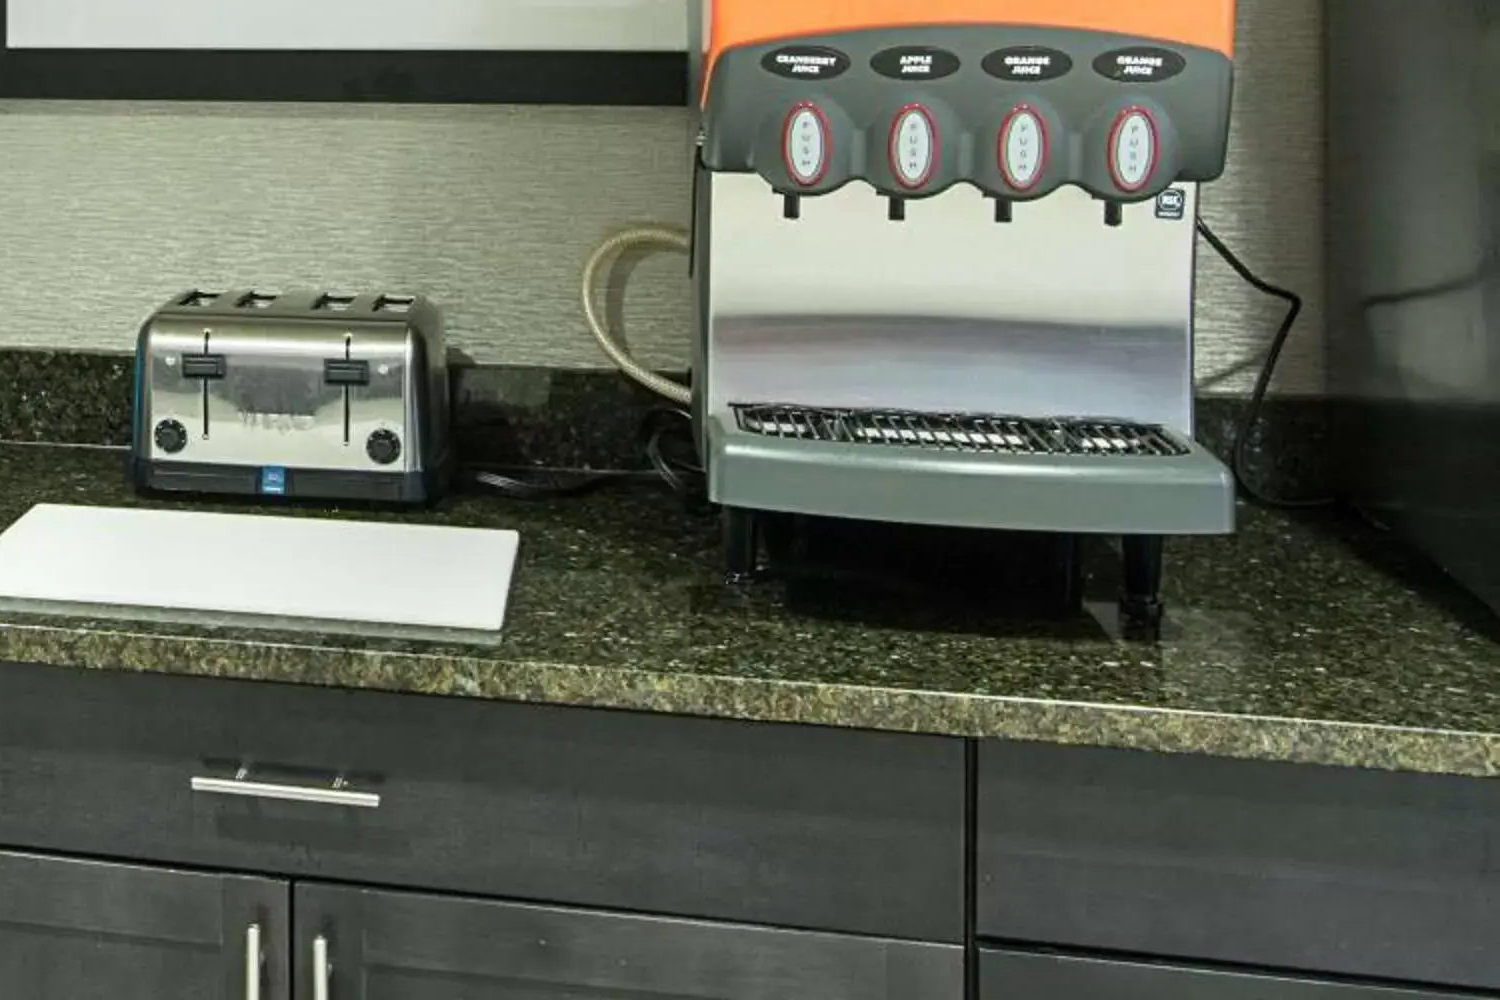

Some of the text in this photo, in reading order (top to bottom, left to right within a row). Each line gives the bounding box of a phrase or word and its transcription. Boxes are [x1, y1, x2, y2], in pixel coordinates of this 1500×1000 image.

[900, 55, 932, 65] APPLE
[1004, 56, 1051, 65] ORANGE
[1116, 55, 1163, 67] ORANGE
[792, 65, 820, 73] JUICE
[901, 65, 931, 73] JUICE
[1012, 65, 1042, 75] JUICE
[1123, 66, 1153, 76] JUICE
